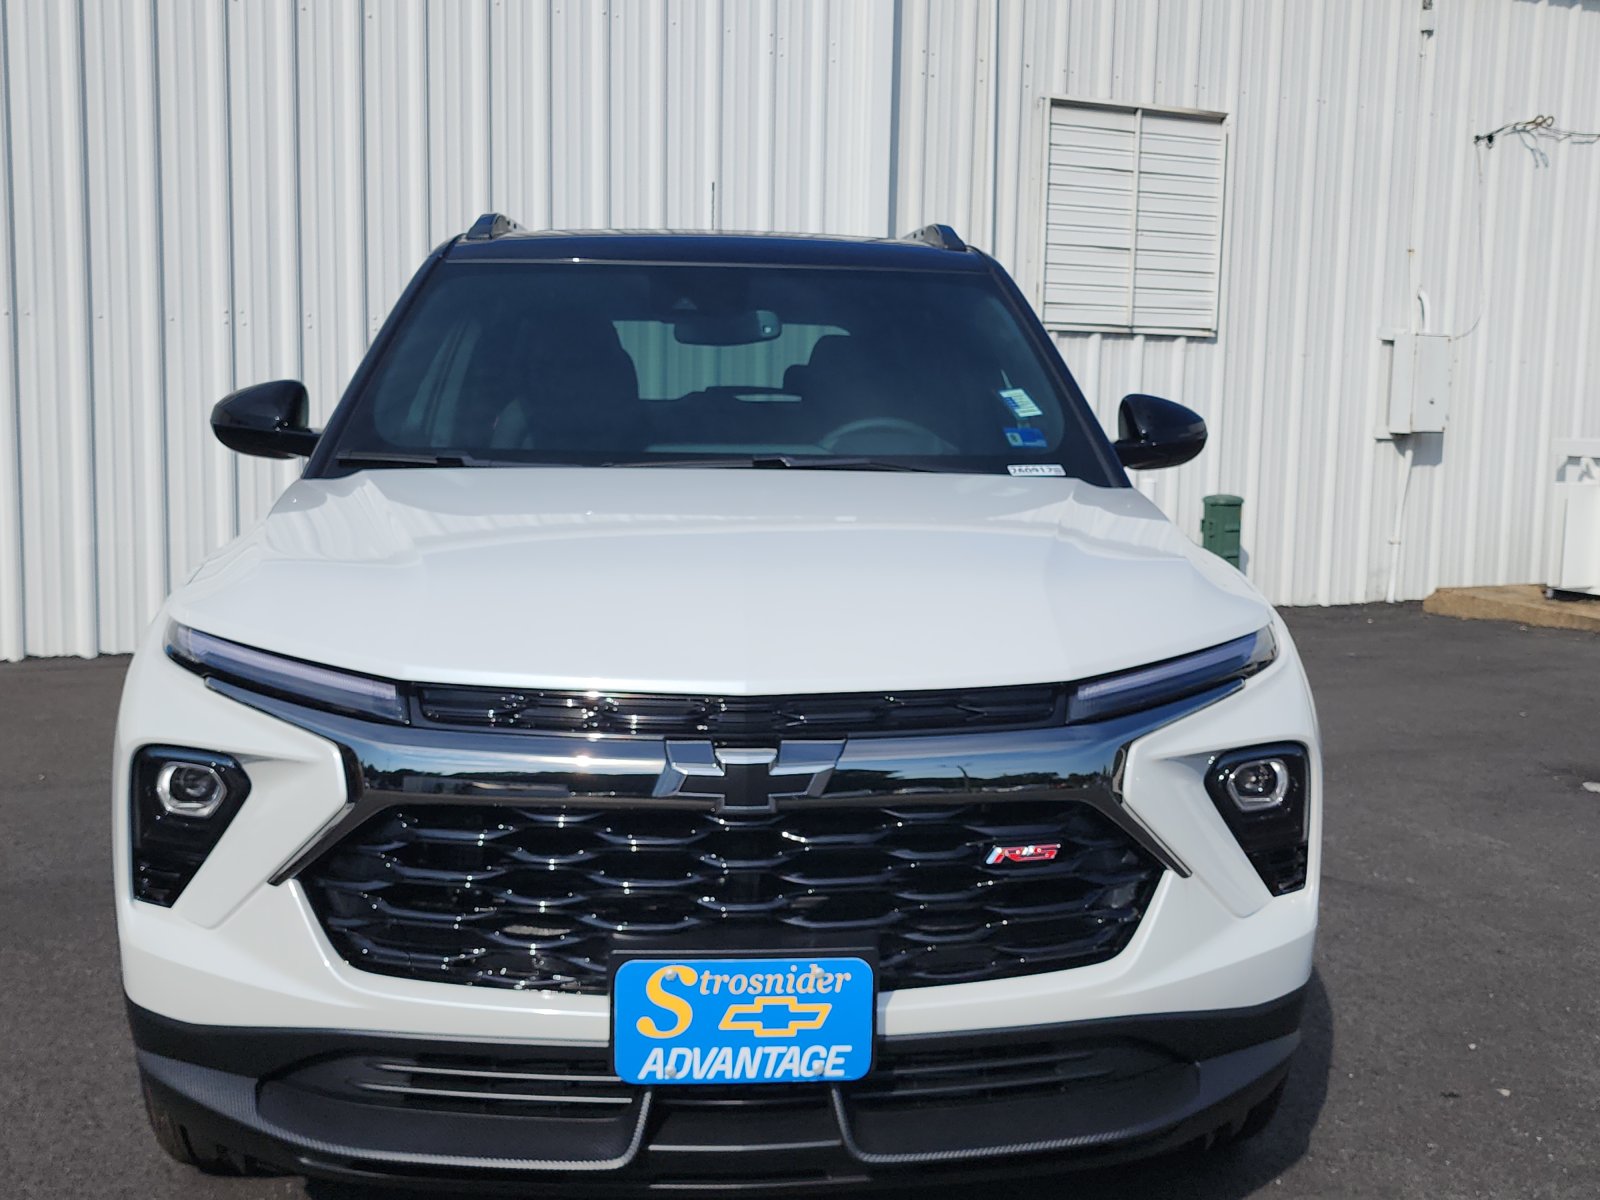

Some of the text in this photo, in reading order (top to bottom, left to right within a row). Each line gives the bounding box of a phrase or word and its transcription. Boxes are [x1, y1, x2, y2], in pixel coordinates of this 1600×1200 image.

[986, 844, 1061, 864] RS
[636, 964, 851, 1039] Strosnider
[637, 1045, 852, 1080] ADVANTAGE
